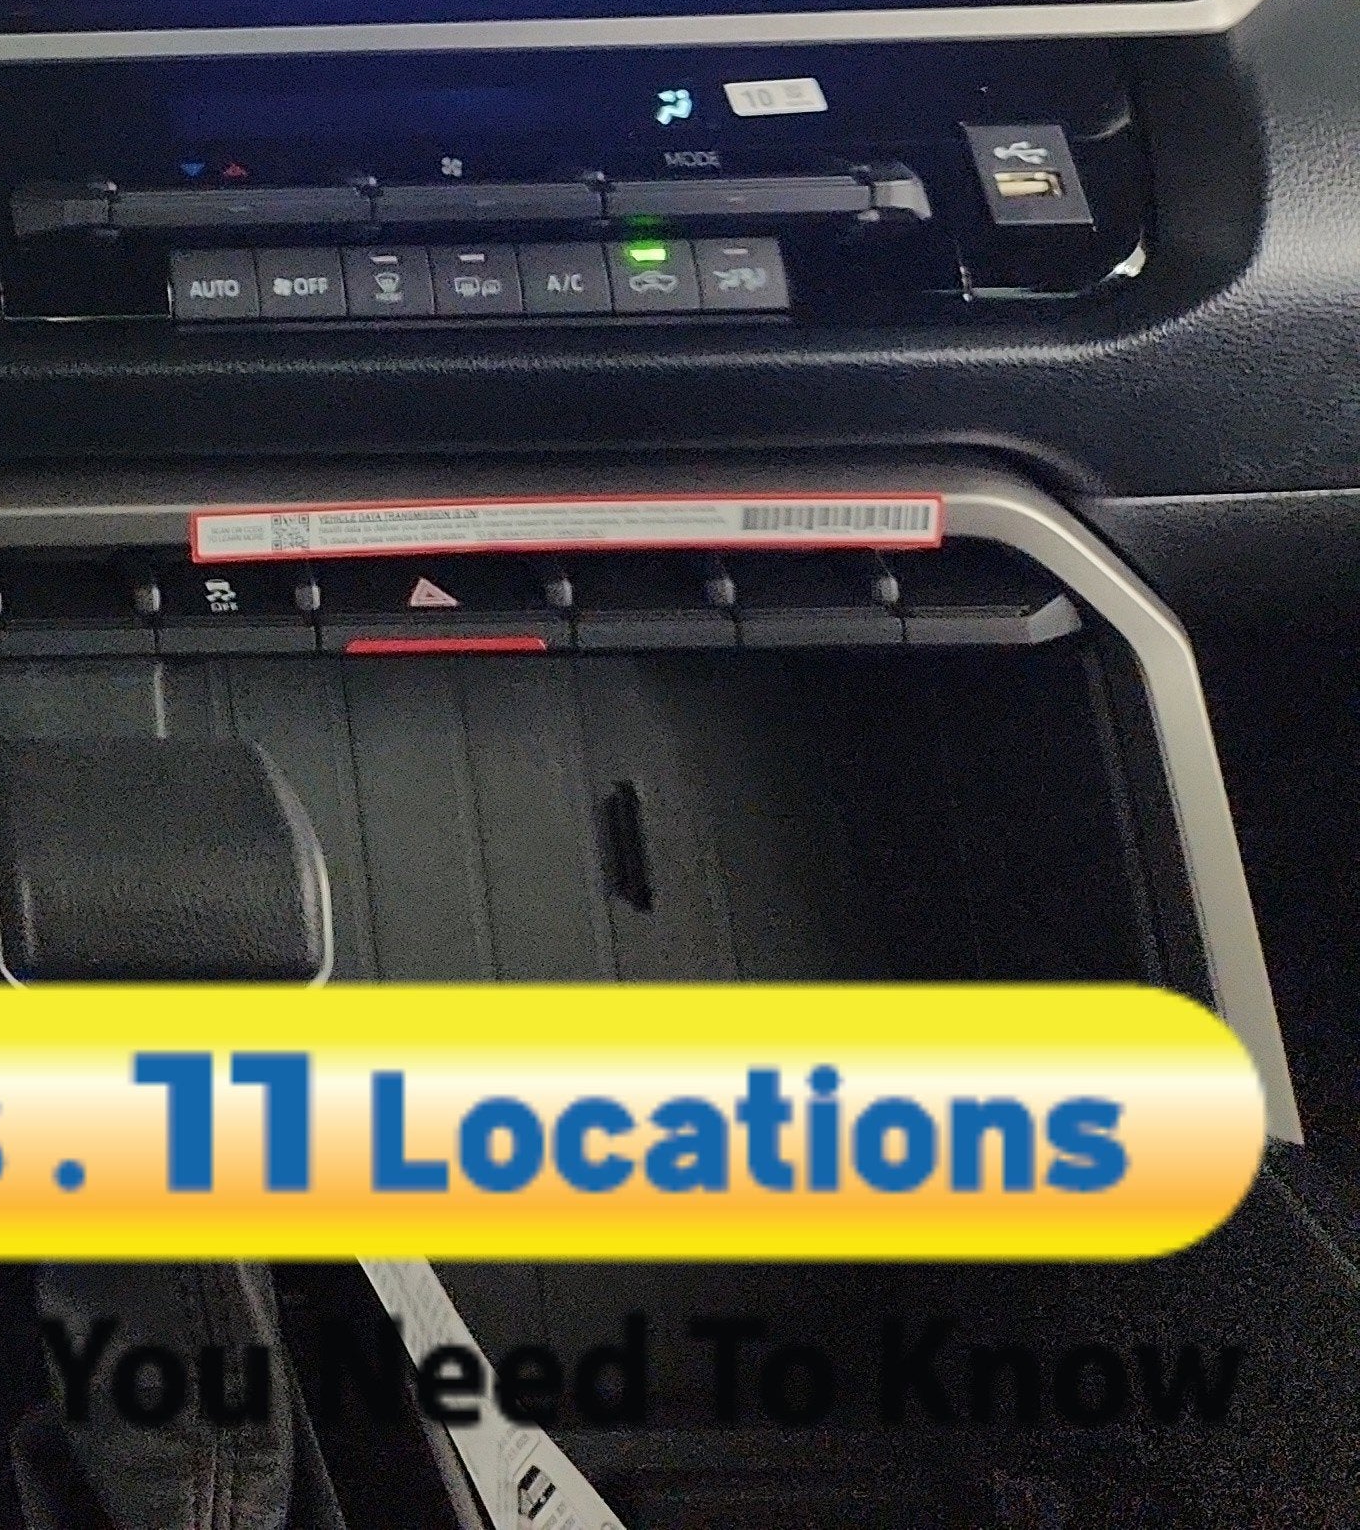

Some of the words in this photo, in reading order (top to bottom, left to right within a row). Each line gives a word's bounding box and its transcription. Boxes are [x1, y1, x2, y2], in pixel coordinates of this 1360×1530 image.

[664, 151, 721, 167] MODE
[190, 279, 240, 299] AUTO
[293, 277, 328, 297] OFF
[546, 274, 583, 293] A/C
